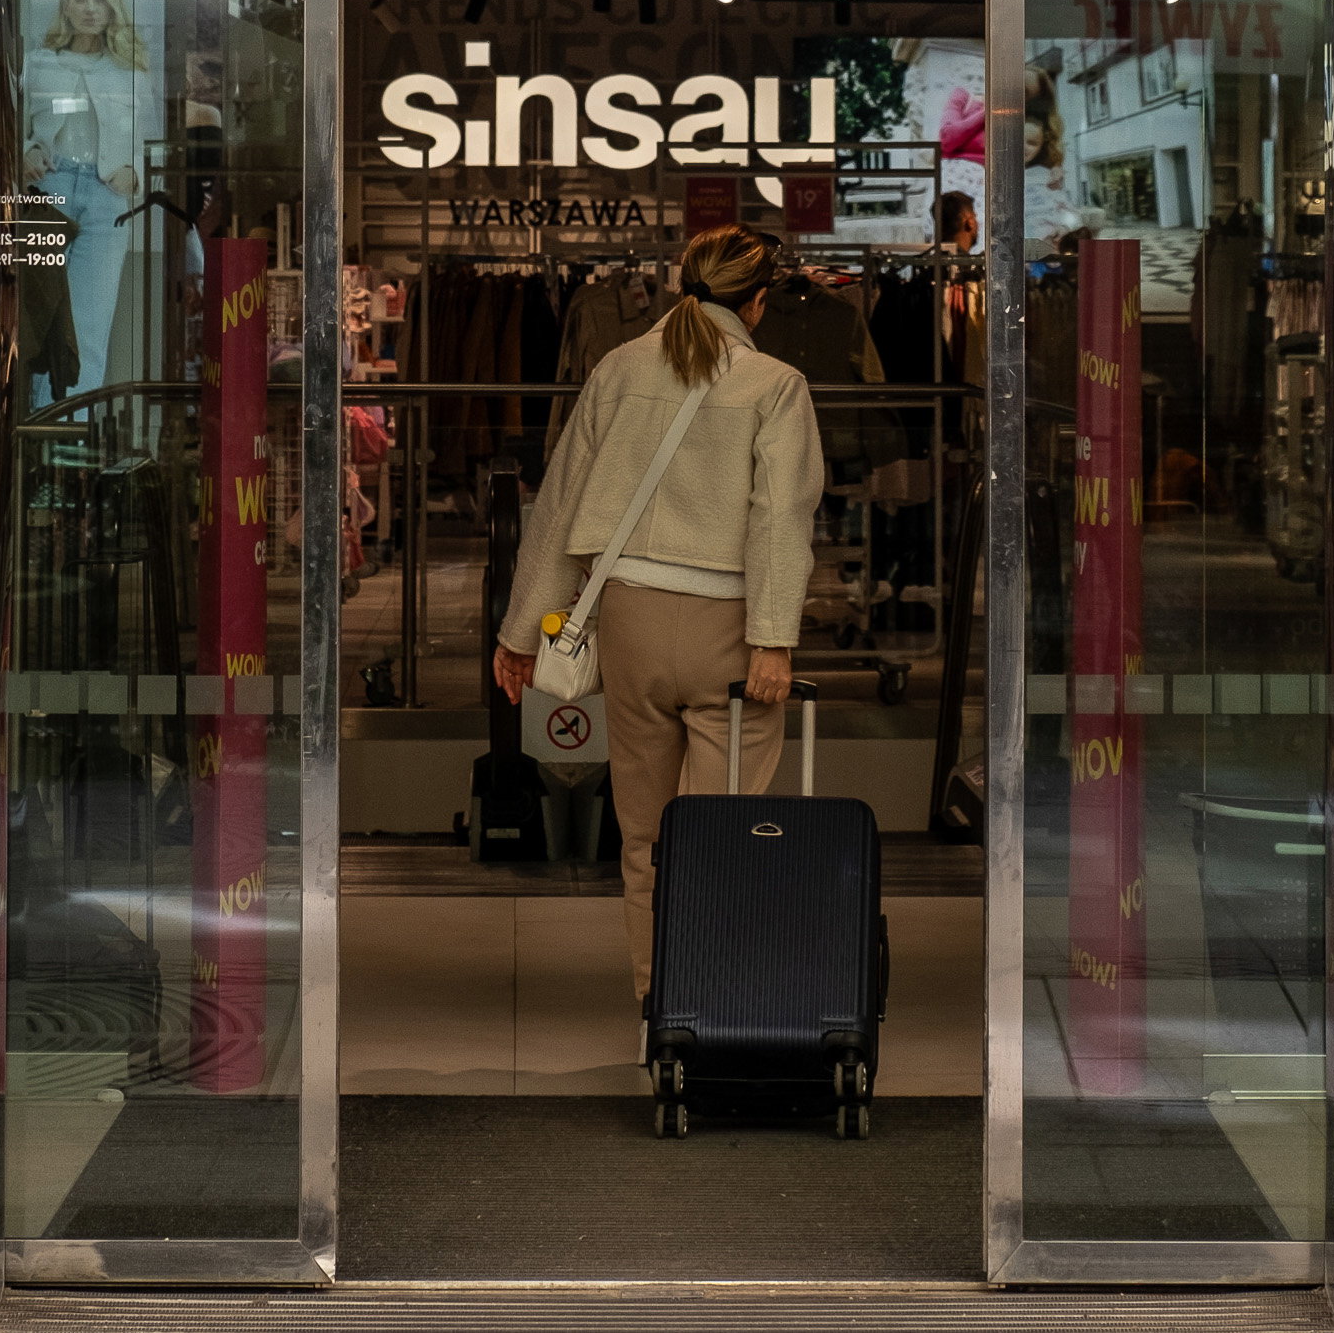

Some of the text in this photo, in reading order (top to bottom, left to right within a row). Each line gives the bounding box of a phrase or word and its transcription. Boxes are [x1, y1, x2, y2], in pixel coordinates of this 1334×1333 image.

[377, 40, 836, 208] sinsay
[17, 193, 66, 205] twarcia
[449, 198, 647, 228] WARSZAWA
[1078, 349, 1121, 390] WOW!
